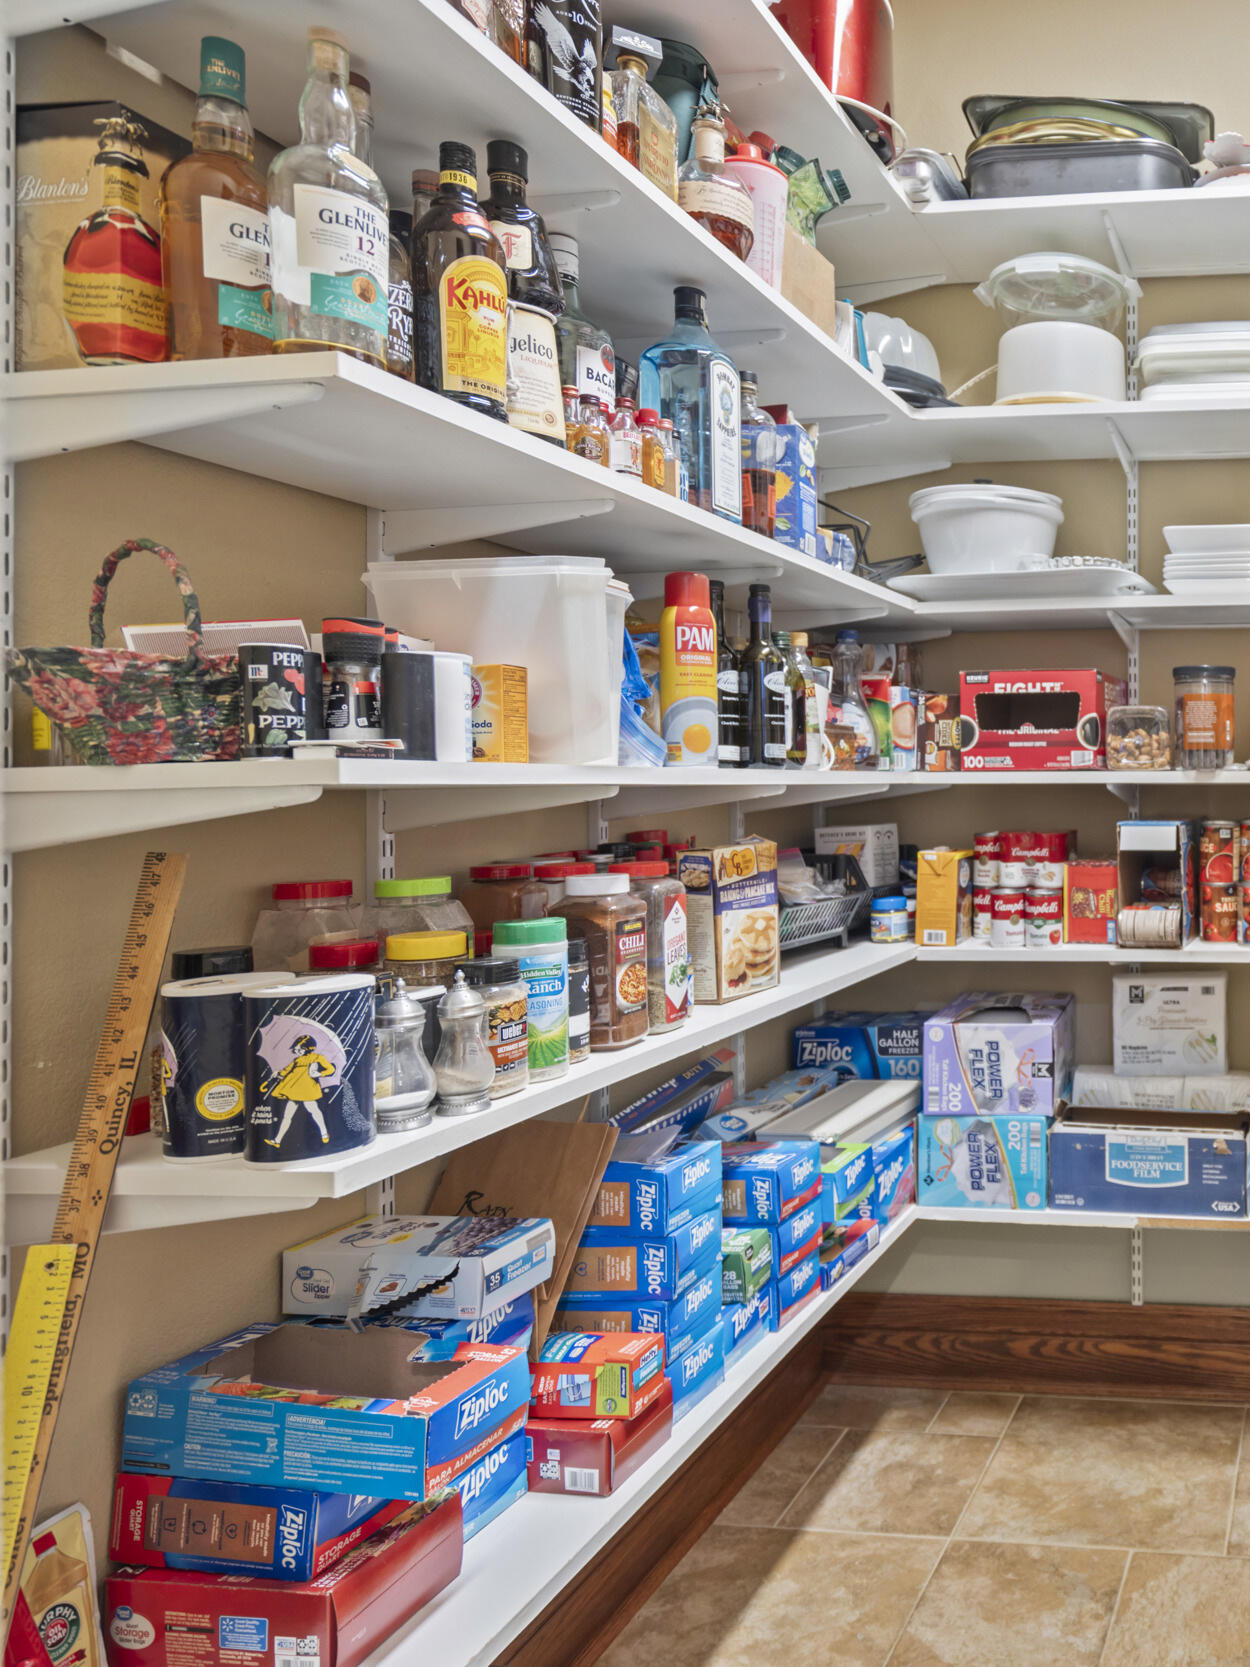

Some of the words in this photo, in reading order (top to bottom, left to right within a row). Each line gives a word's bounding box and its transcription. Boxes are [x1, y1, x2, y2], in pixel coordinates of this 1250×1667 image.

[572, 11, 585, 25] 10
[17, 175, 89, 200] Blanton's
[319, 208, 388, 247] GLENLIVE
[353, 206, 376, 224] THE
[357, 236, 375, 257] 12
[447, 277, 506, 313] KAHLÚ
[510, 334, 553, 360] gelico
[462, 379, 478, 388] THE
[676, 626, 714, 651] PAM
[273, 651, 304, 668] PEPP
[258, 715, 304, 729] PEPP
[963, 756, 984, 768] 100
[619, 933, 645, 950] CHILI
[520, 968, 545, 979] Hidden
[546, 967, 561, 978] Valley
[879, 1038, 919, 1048] GALLON
[893, 1029, 919, 1040] HALF
[802, 1042, 852, 1063] Ziploc
[888, 1059, 920, 1076] 160
[971, 1048, 986, 1091] FLEX
[986, 1040, 1003, 1100] POWER
[99, 1078, 132, 1156] Quincy,
[120, 1050, 138, 1072] IL
[948, 1081, 962, 1112] 200
[1007, 1121, 1021, 1151] 200
[683, 1158, 711, 1187] Ziploc
[793, 1158, 814, 1186] Ziploc
[845, 1154, 866, 1190] Ziploc
[968, 1131, 985, 1191] POWER
[985, 1142, 1001, 1184] FLEX
[1111, 1159, 1184, 1172] FOODSERVICE
[1133, 1168, 1161, 1179] FILM
[878, 1155, 904, 1203] Ziploc
[636, 1184, 656, 1232] Ziploc
[752, 1180, 771, 1221] Ziploc
[691, 1217, 715, 1249] Ziploc
[793, 1211, 815, 1241] Ziploc
[489, 1270, 501, 1287] 35
[506, 1263, 532, 1281] Freezer
[644, 1247, 665, 1295] Ziploc
[302, 1281, 330, 1295] Slider
[686, 1280, 712, 1313] Ziploc
[466, 1297, 515, 1343] Ziploc
[684, 1343, 714, 1378] Ziploc
[460, 1381, 509, 1429] Ziploc
[429, 1466, 452, 1489] PARA
[454, 1428, 504, 1472] ALMACENAR
[461, 1444, 508, 1506] Ziploc
[132, 1499, 144, 1541] STORAGE
[280, 1508, 305, 1570] Ziploc
[318, 1526, 362, 1565] STORAGE
[46, 1627, 69, 1647] SOAP
[114, 1626, 150, 1640] Storage
